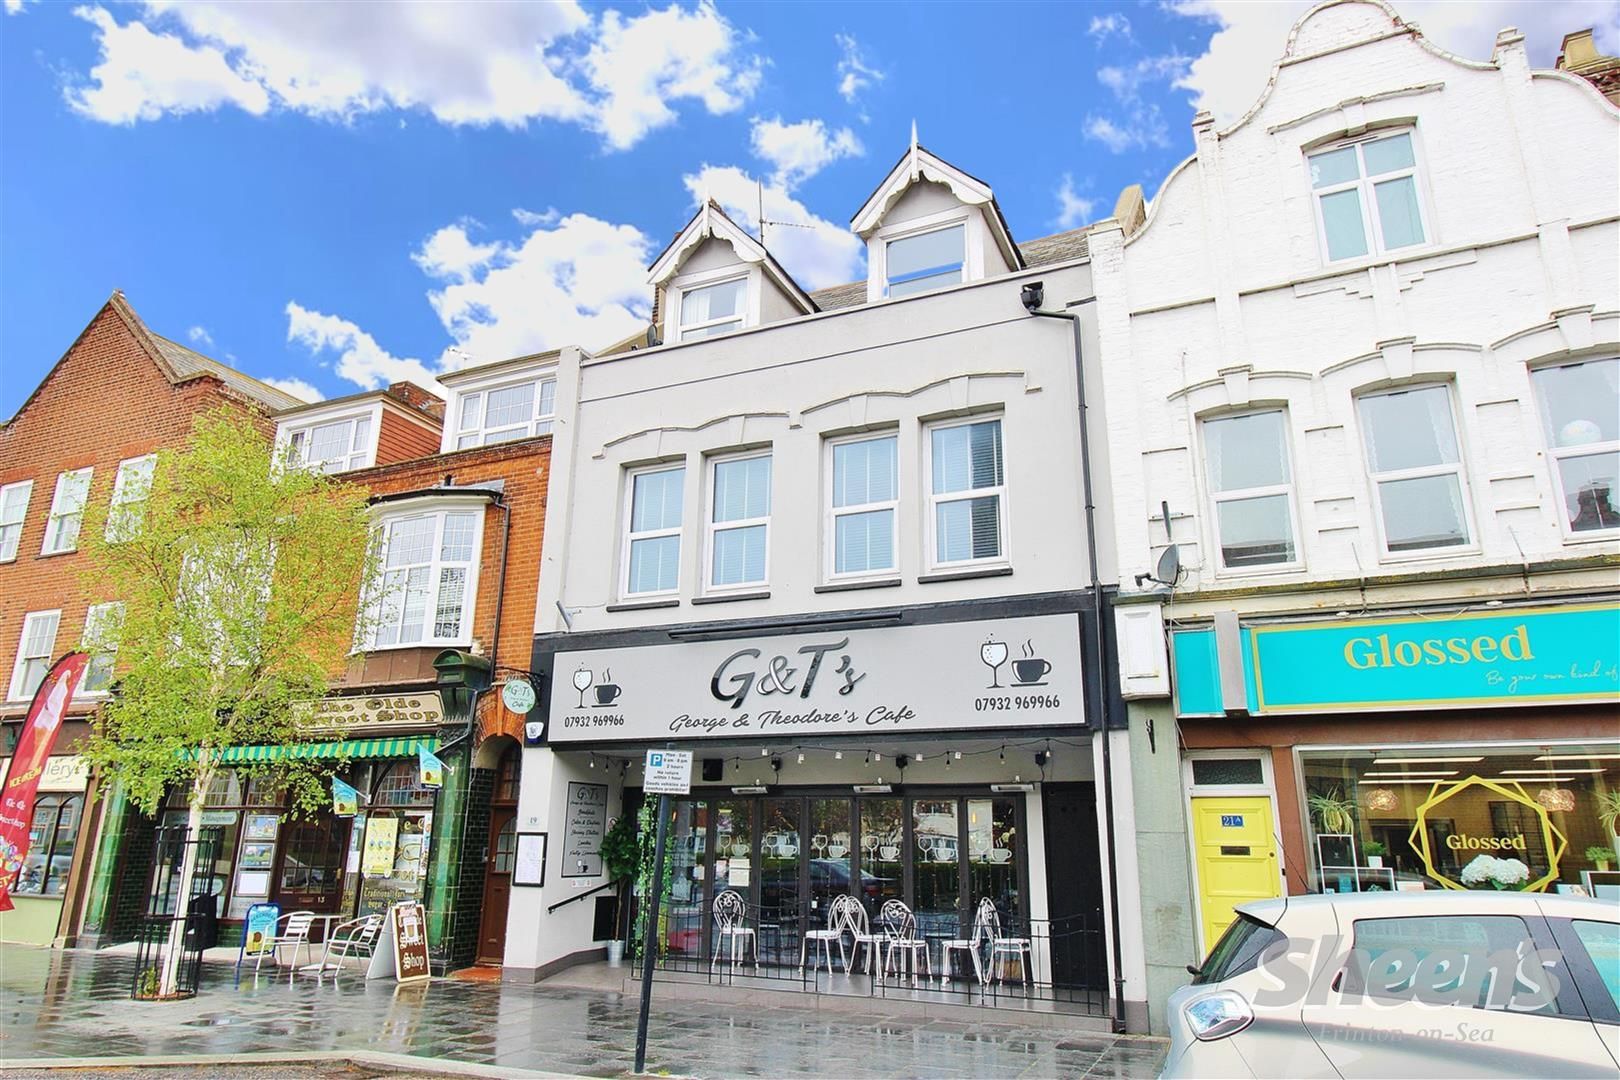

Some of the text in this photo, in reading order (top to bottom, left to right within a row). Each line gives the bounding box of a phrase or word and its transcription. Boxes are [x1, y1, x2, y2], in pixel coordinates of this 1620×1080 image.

[1344, 624, 1535, 669] Glossed
[710, 637, 866, 709] G&T's
[1486, 670, 1504, 685] Be
[1508, 674, 1537, 693] your
[1570, 660, 1601, 679] kind
[1605, 664, 1618, 681] of
[365, 698, 421, 711] Olde
[975, 694, 1060, 711] 07932 969966
[376, 710, 439, 722] Shop
[564, 714, 625, 728] 07932 969966
[669, 704, 916, 732] George & Theodore's Cafe
[653, 755, 661, 765] P
[1446, 834, 1526, 850] Glossed
[403, 952, 424, 970] Shop
